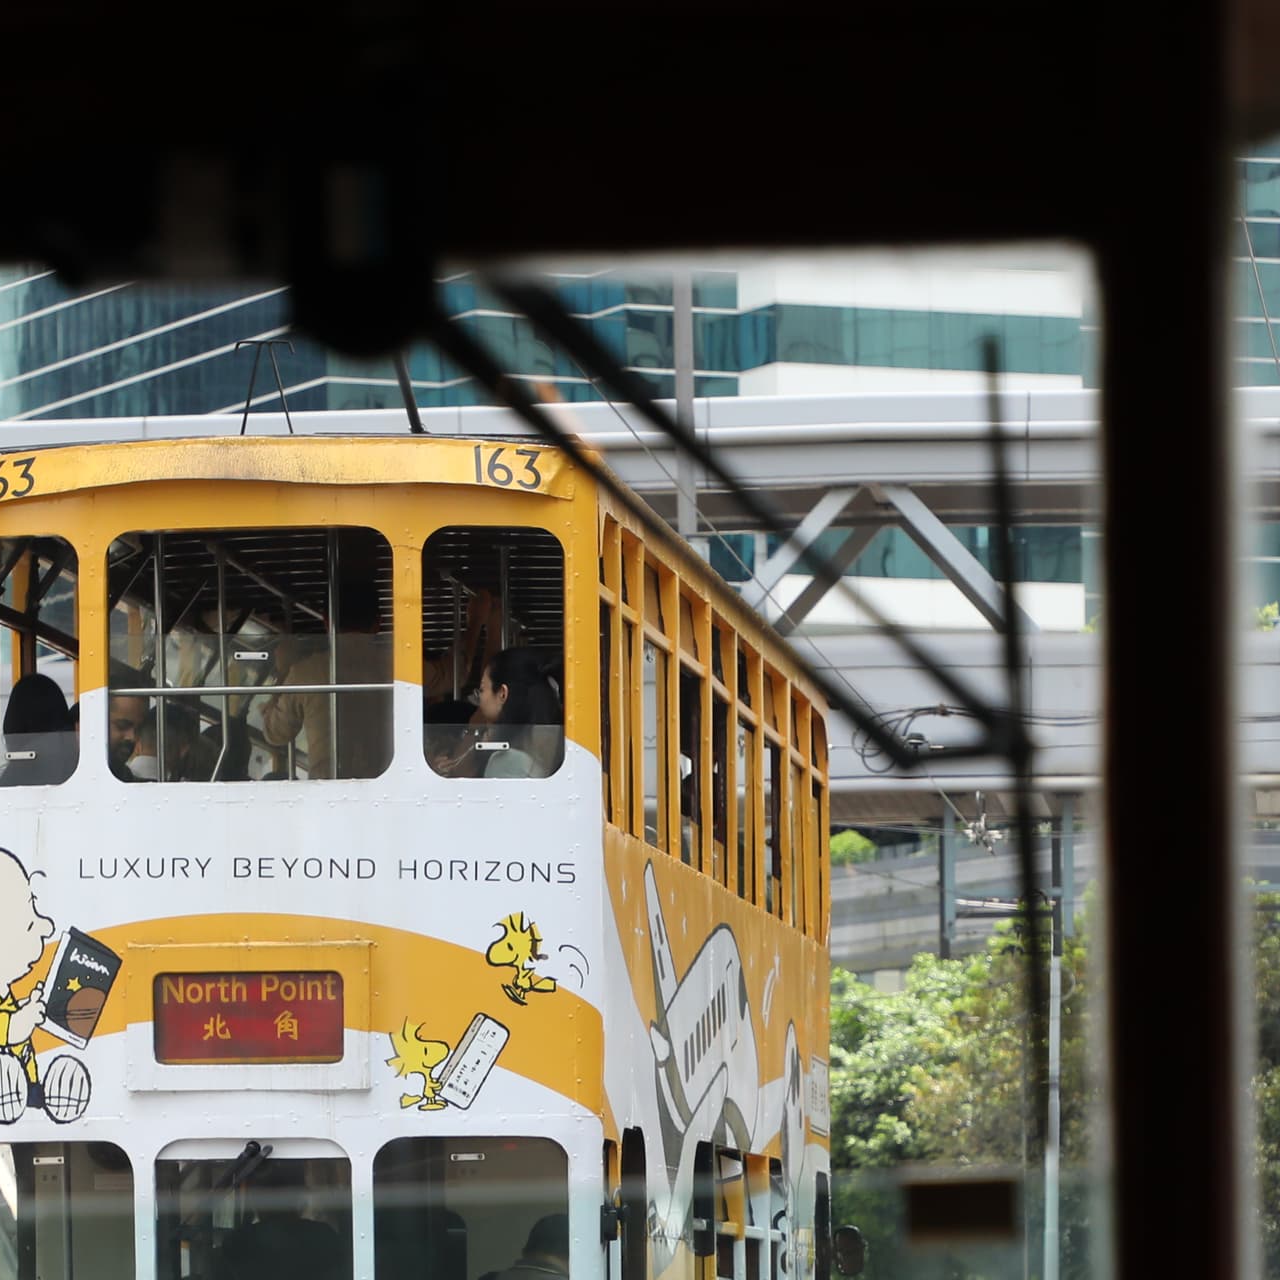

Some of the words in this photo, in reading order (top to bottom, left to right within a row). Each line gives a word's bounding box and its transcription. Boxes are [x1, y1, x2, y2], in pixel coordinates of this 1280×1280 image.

[473, 445, 543, 490] 163
[79, 857, 212, 879] LUXURY
[233, 857, 376, 879] BEYOND
[398, 859, 577, 884] HORIZONS
[162, 976, 247, 1004] North
[261, 974, 337, 1001] Point
